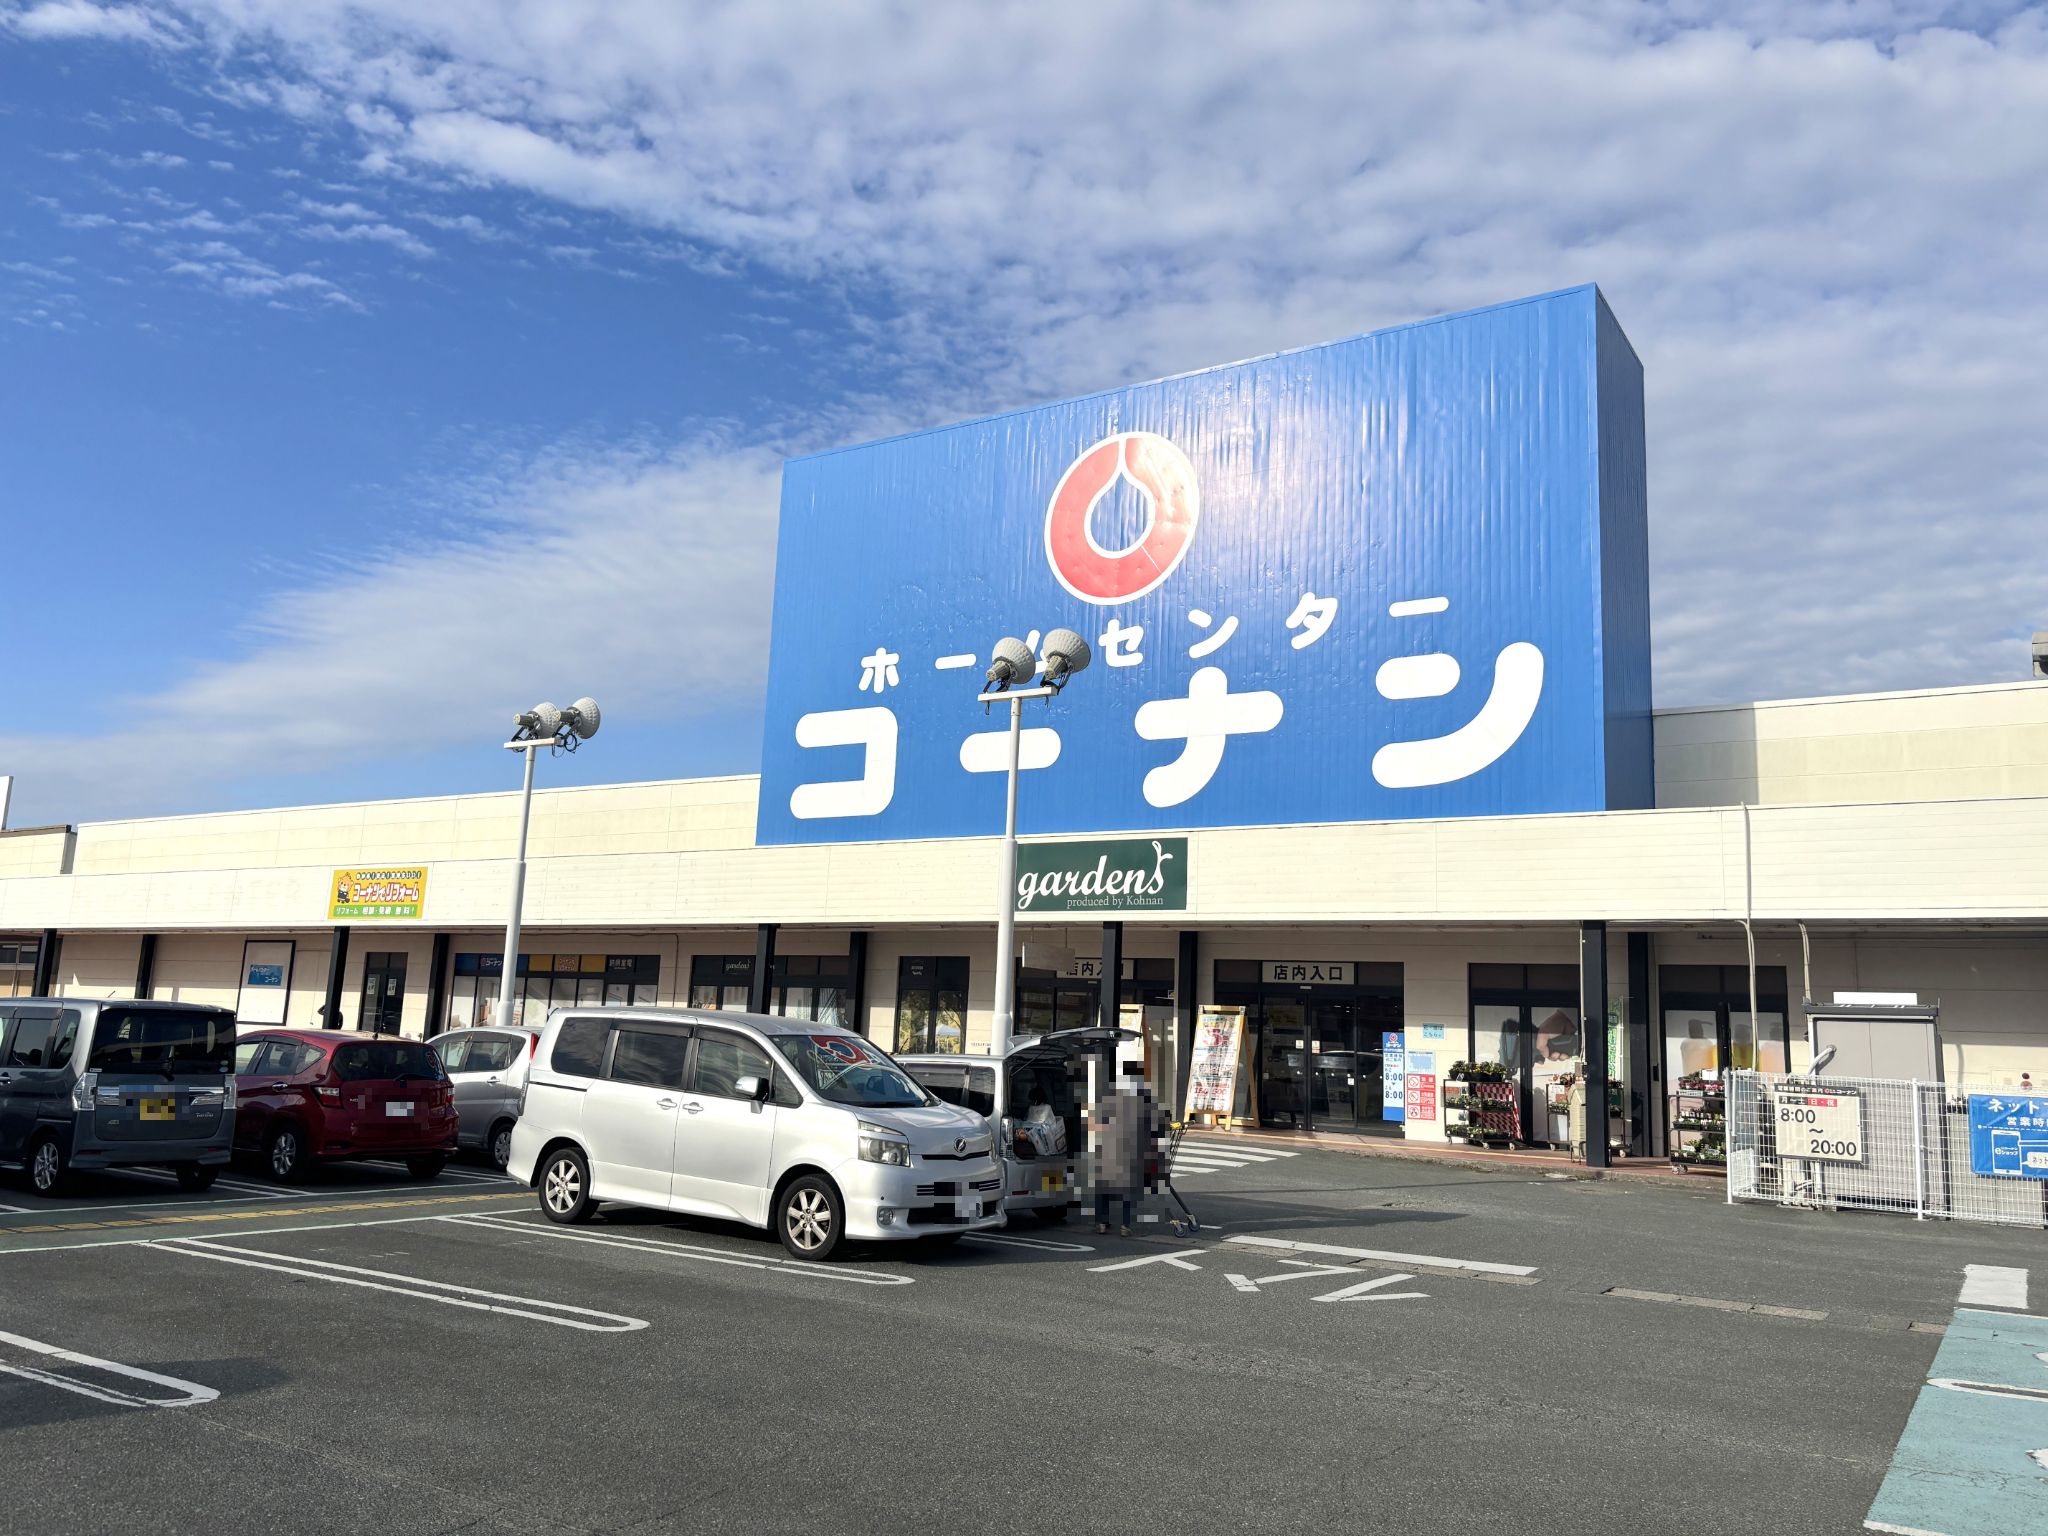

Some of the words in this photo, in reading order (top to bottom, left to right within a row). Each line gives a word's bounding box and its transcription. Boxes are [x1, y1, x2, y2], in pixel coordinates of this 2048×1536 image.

[789, 641, 1544, 820] コーナン
[1017, 840, 1174, 909] gardens
[352, 882, 419, 902] コーナンでリフォーム
[1067, 896, 1109, 909] produced
[1112, 896, 1123, 908] by
[1126, 895, 1164, 906] Kohnan
[1273, 965, 1343, 981] 店内入口
[1385, 1073, 1403, 1081] 8:00
[1385, 1091, 1403, 1099] 8:00
[1988, 1099, 2048, 1115] ネット
[1780, 1108, 1816, 1123] 8:00
[2006, 1116, 2048, 1128] 営業時
[1811, 1139, 1857, 1156] 20:00
[1085, 1248, 1431, 1302] トマレ
